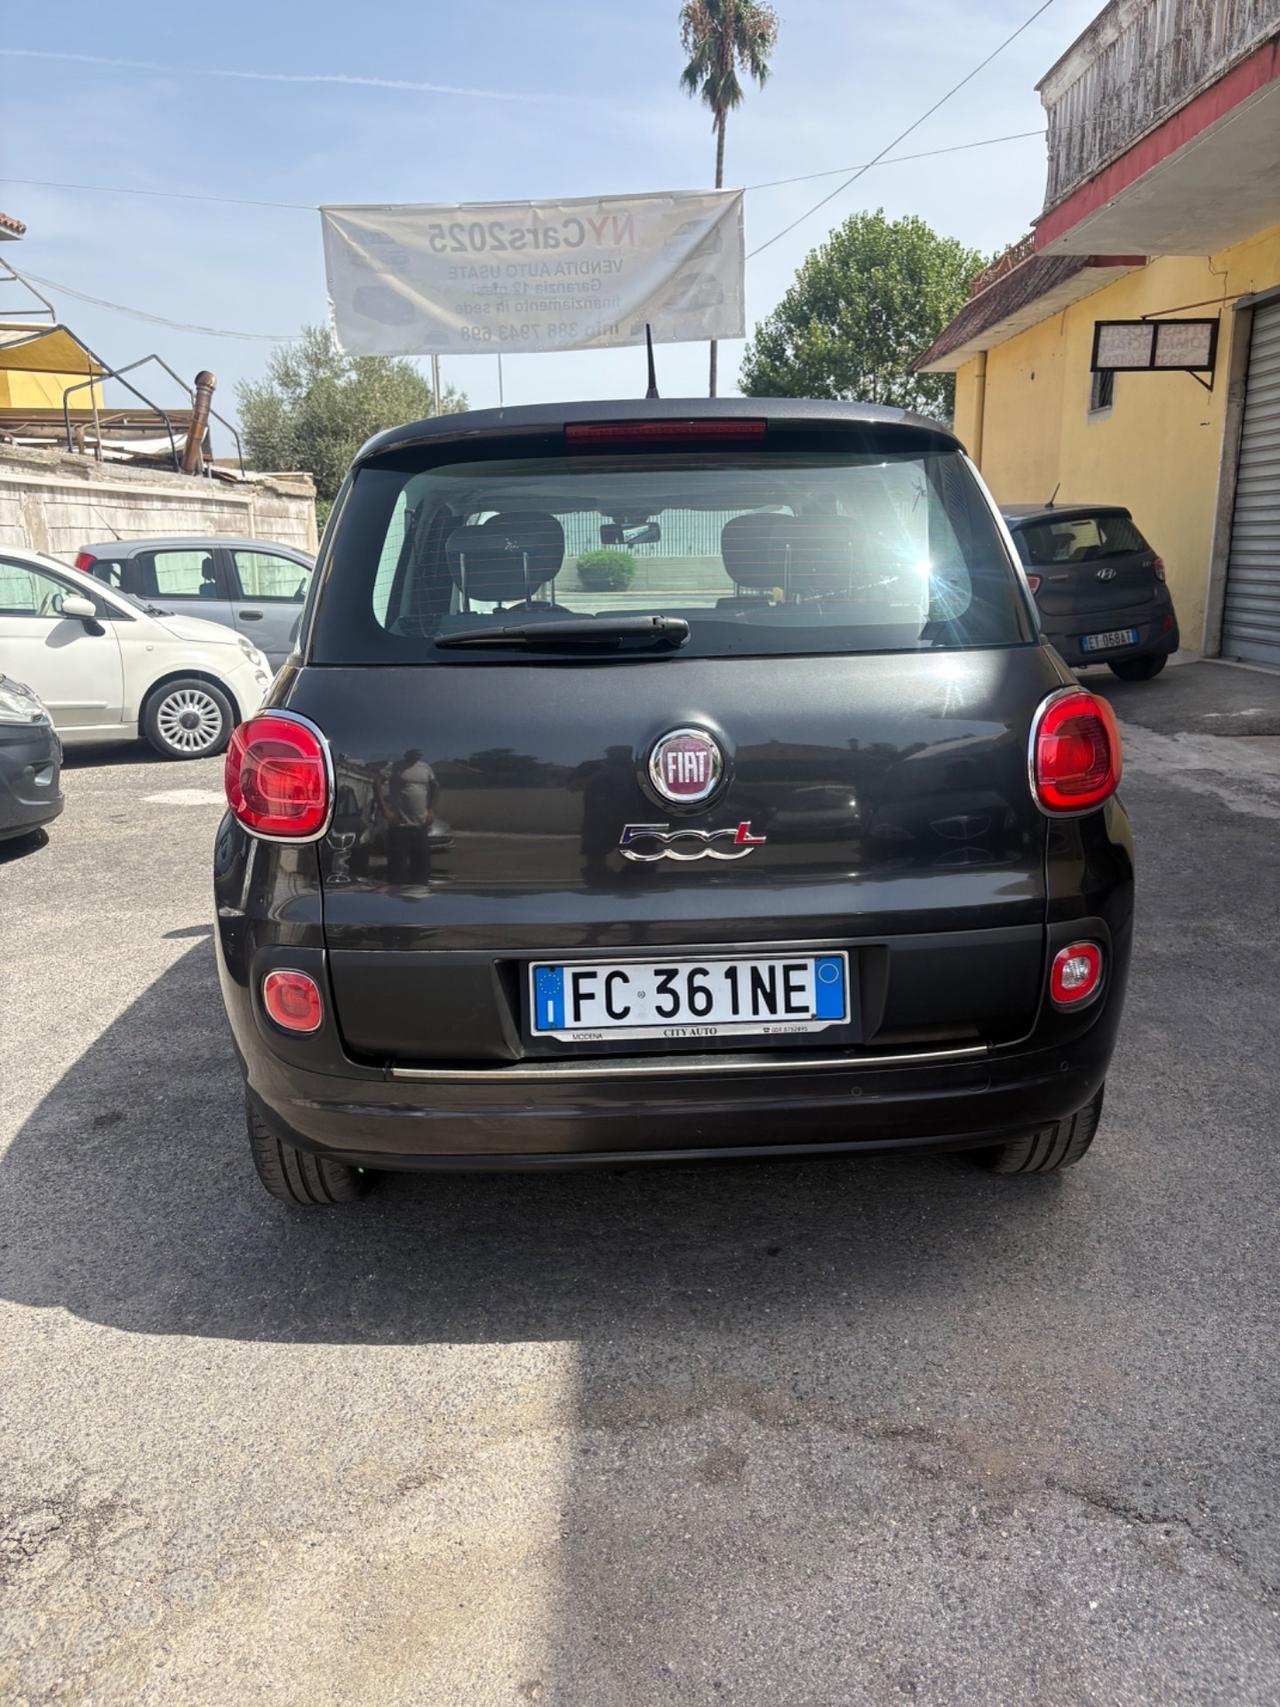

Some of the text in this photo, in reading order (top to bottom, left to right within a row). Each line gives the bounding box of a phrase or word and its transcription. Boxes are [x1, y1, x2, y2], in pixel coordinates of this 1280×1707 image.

[667, 750, 708, 784] FIAT
[618, 820, 767, 862] 500L
[572, 970, 631, 1022] FC
[653, 963, 810, 1018] 361NE
[572, 1032, 603, 1041] MODENA
[663, 1028, 687, 1038] CITY
[689, 1027, 718, 1037] AUTO
